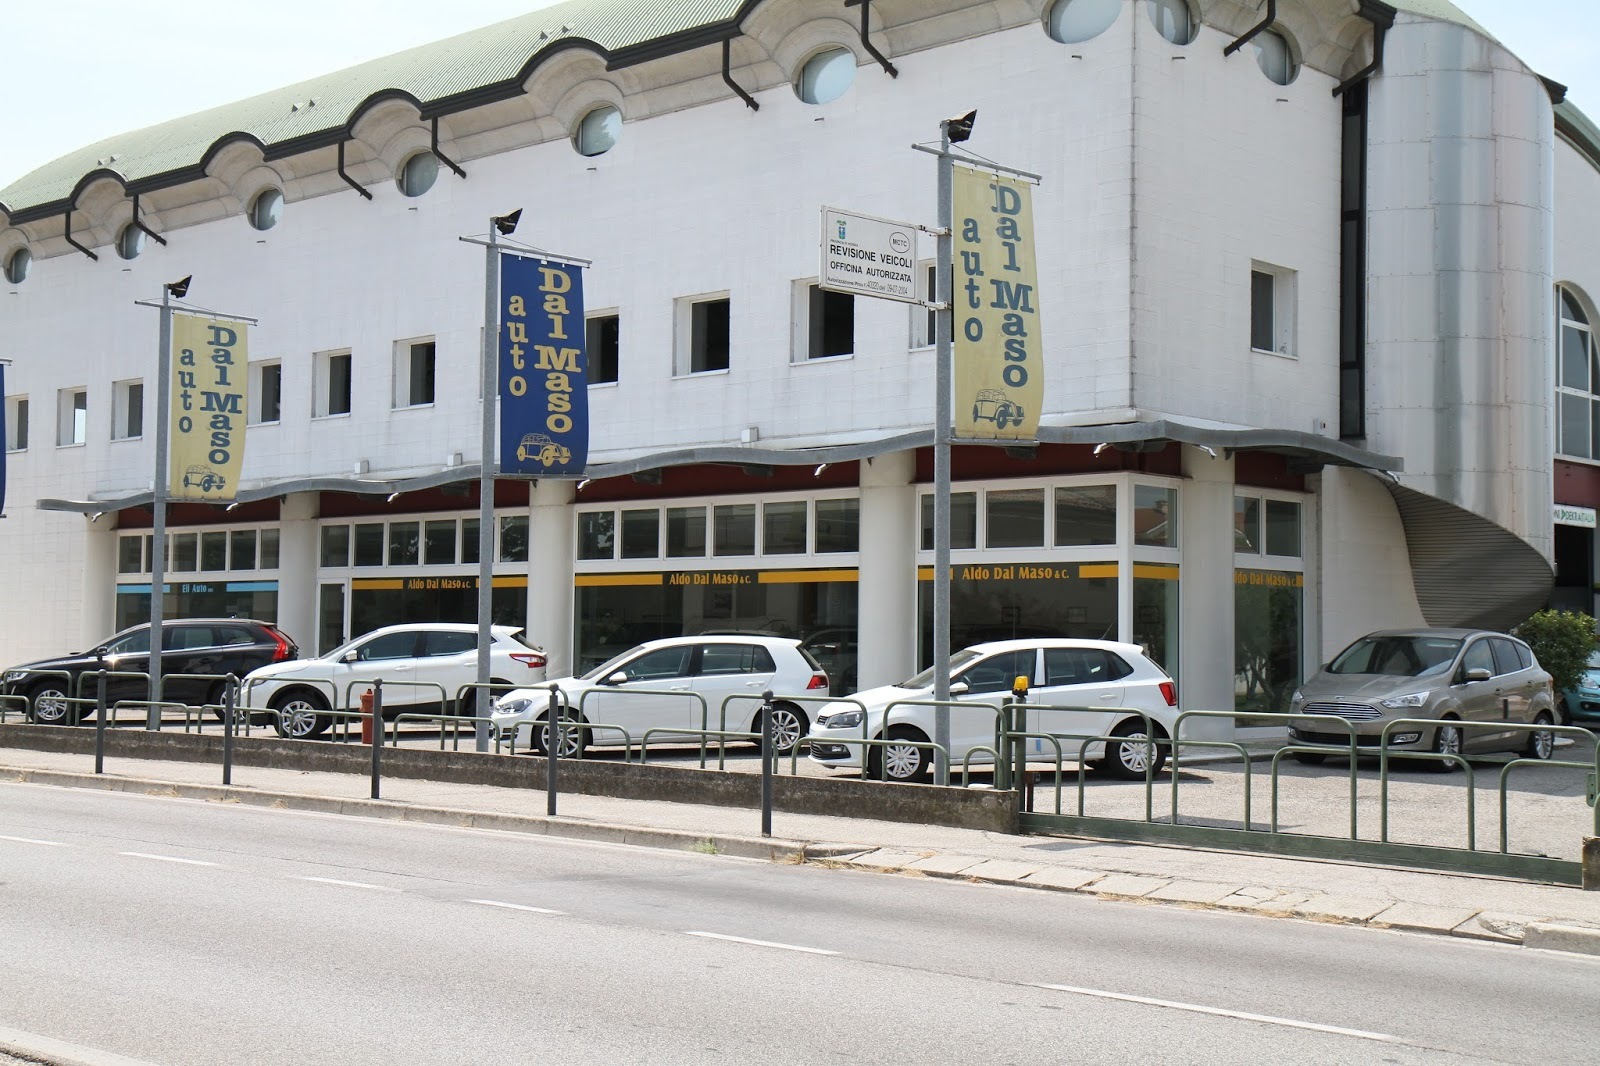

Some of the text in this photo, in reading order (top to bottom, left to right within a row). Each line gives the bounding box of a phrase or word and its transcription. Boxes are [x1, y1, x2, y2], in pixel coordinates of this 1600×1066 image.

[892, 238, 908, 248] MCTC
[830, 244, 912, 268] REVISIONE VEICOLI
[830, 260, 912, 283] OFFICINA AUTORIZZATA
[960, 217, 985, 343] auto
[989, 183, 1035, 388] Dal Maso
[507, 295, 529, 397] auto
[534, 266, 582, 434] Dal Maso
[178, 348, 196, 433] auto
[200, 325, 243, 465] Dal Maso
[408, 578, 425, 589] Aldo
[426, 578, 439, 589] Dal
[441, 578, 461, 589] Maso
[669, 573, 691, 585] Aldo
[693, 573, 710, 585] Dal
[712, 573, 739, 584] Maso
[962, 566, 990, 580] Aldo
[993, 566, 1014, 580] Dal
[1018, 566, 1052, 579] Maso
[1234, 571, 1247, 584] ldo
[1249, 572, 1263, 585] Dal
[1266, 573, 1286, 586] Maso
[182, 584, 190, 593] Eli
[191, 584, 207, 593] Auto
